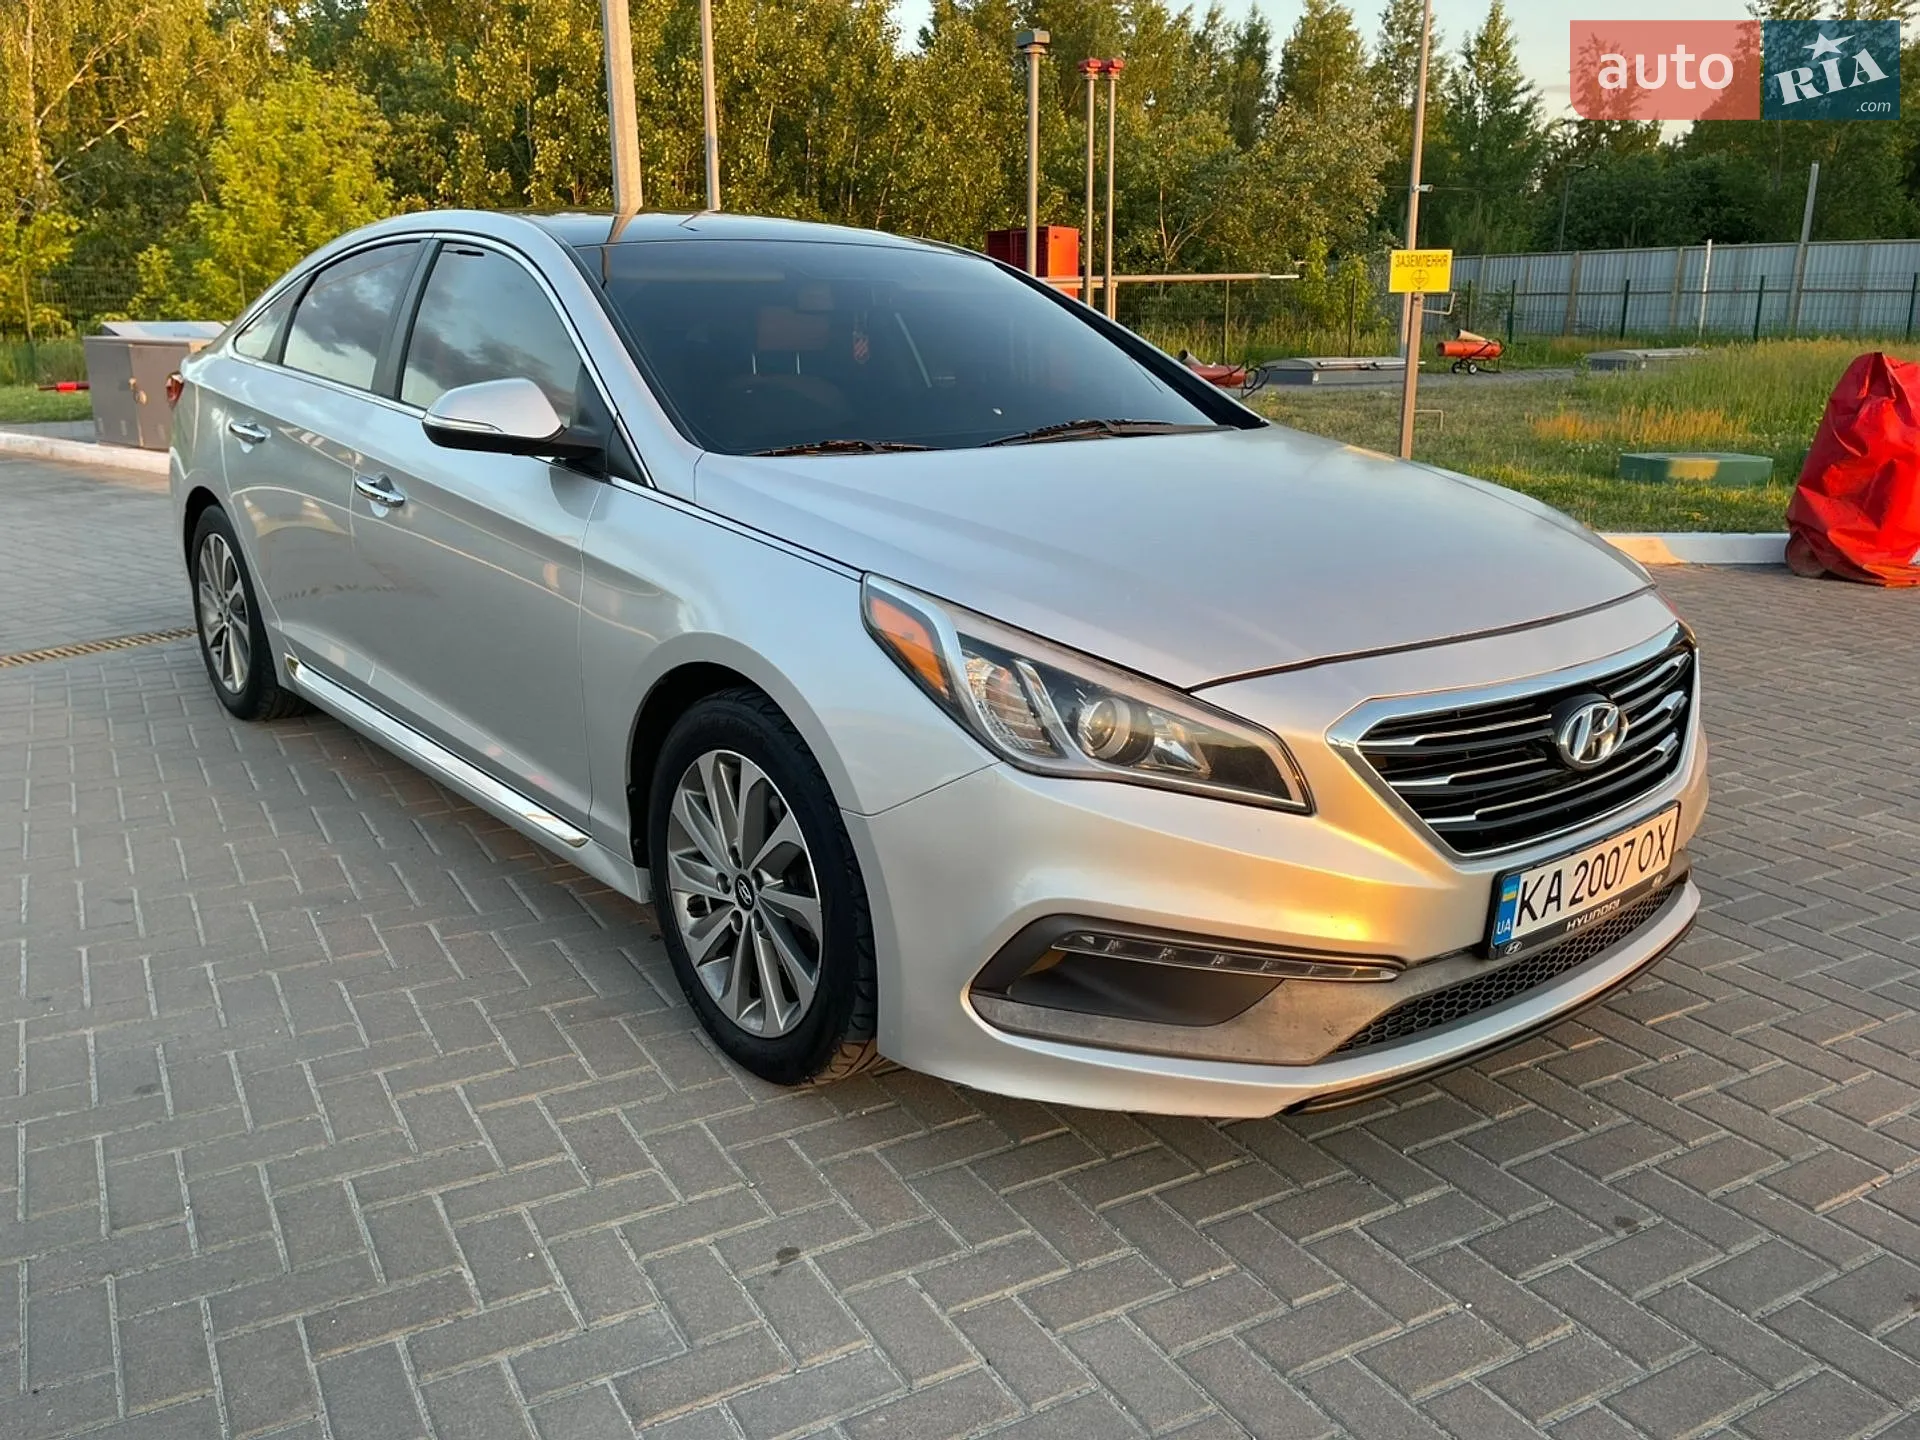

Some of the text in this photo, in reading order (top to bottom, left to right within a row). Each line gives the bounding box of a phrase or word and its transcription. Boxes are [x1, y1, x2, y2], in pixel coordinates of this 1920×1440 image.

[1517, 819, 1672, 927] KA 2007 OX
[1497, 919, 1511, 935] UA
[1566, 899, 1620, 931] HYUNDAI
